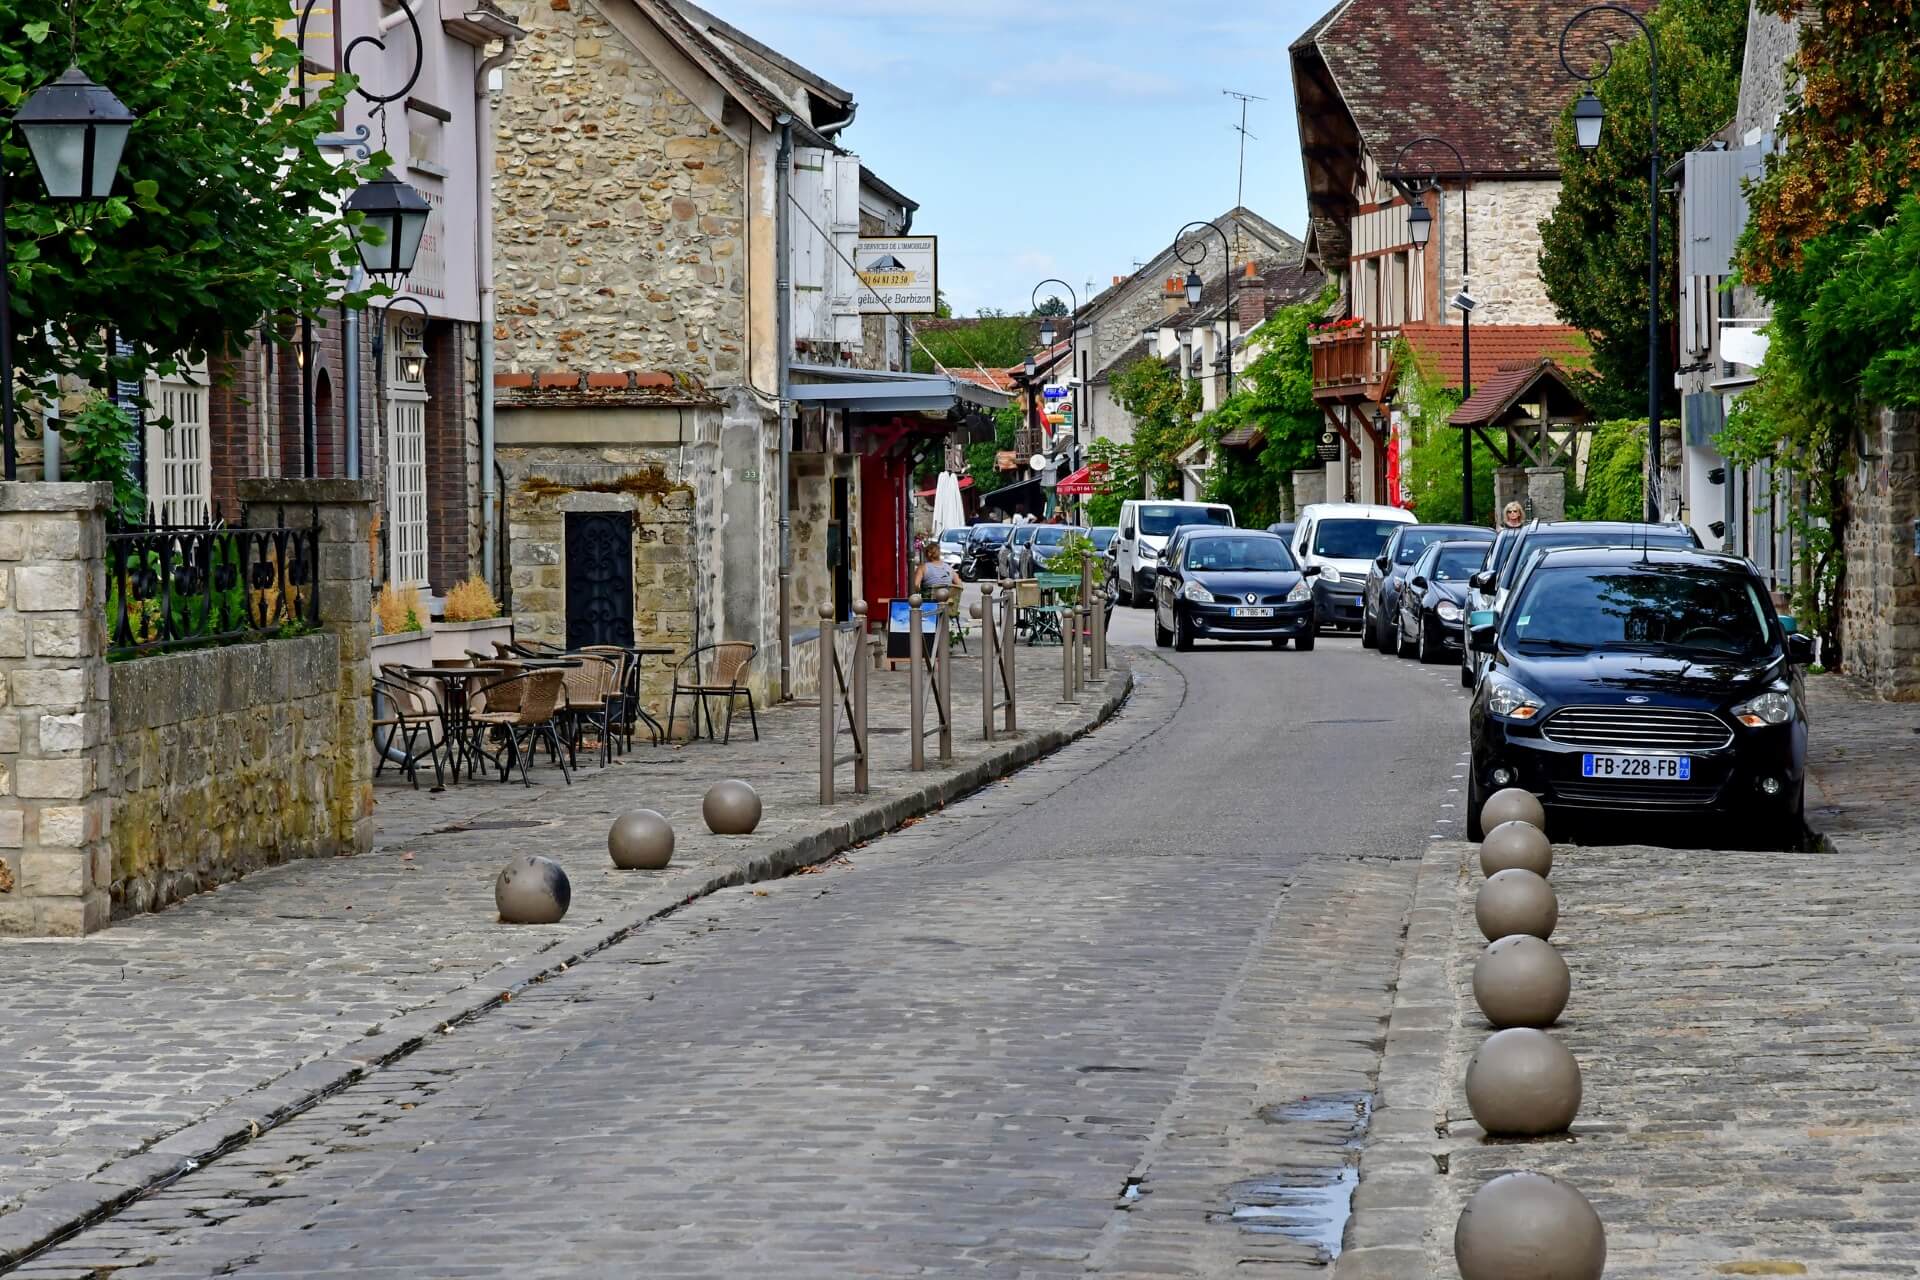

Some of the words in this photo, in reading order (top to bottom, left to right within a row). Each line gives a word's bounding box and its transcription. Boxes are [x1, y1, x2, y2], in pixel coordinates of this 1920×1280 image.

[881, 292, 893, 304] de
[895, 293, 931, 304] Barbizon
[1595, 758, 1677, 776] FB-228-FB
